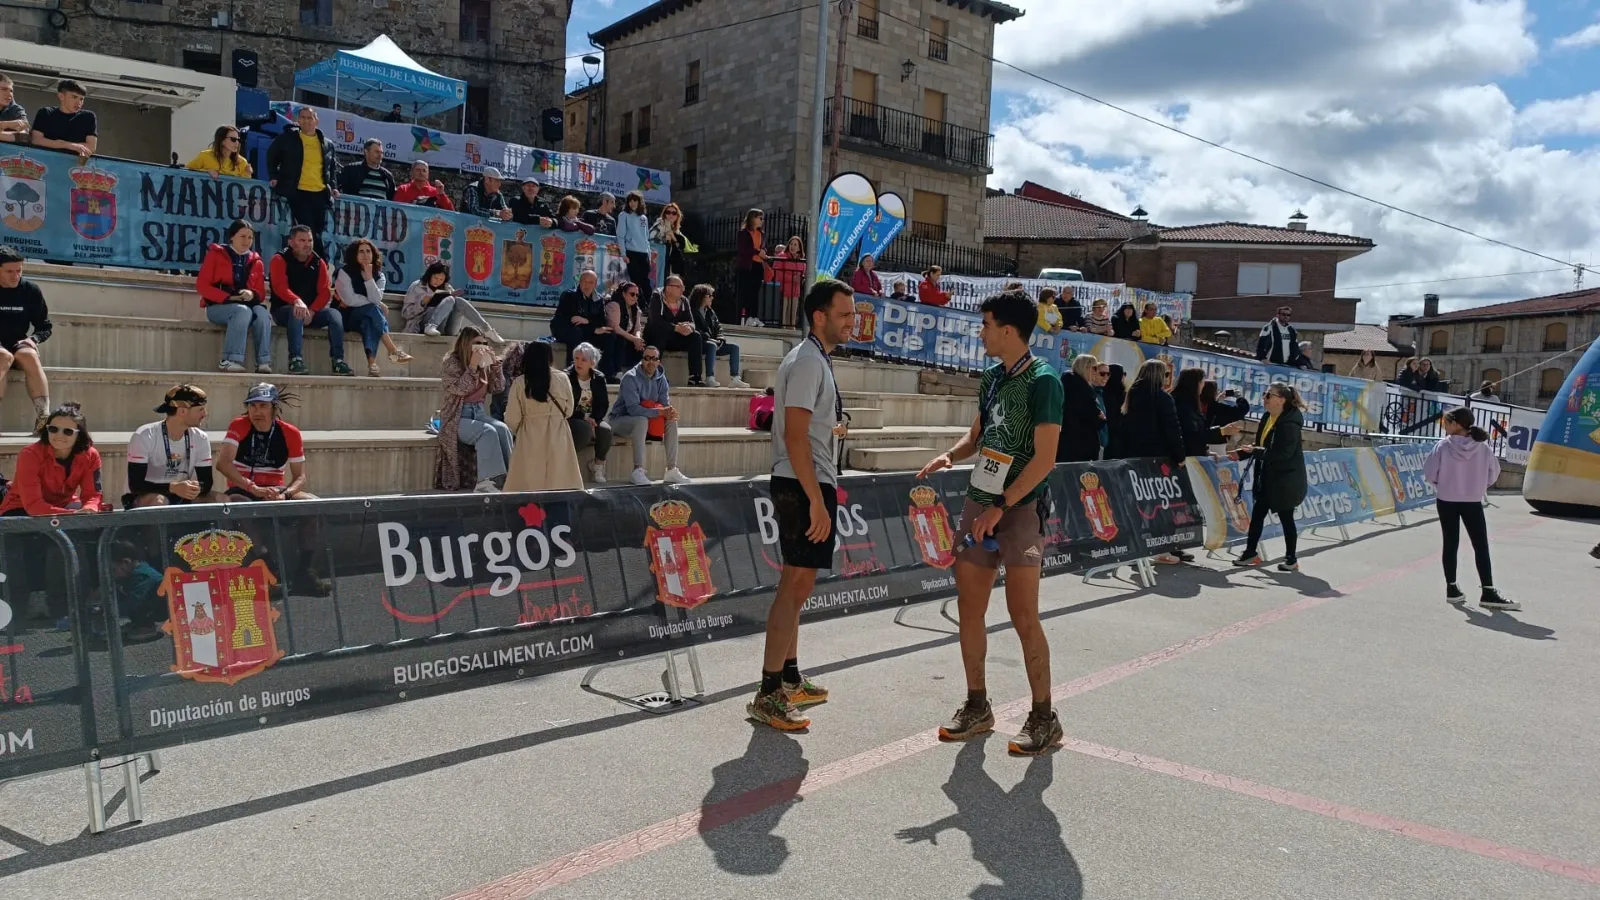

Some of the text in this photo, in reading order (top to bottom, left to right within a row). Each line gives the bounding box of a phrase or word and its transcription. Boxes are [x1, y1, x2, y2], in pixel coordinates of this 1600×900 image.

[339, 57, 389, 78] REGUMIEL
[390, 68, 402, 81] DE
[404, 72, 417, 86] LA
[418, 76, 453, 93] SIERRA
[460, 162, 485, 172] Castill
[140, 171, 408, 243] MANCOMNIDAD
[847, 207, 873, 246] BURGOS
[883, 328, 925, 351] de
[1181, 355, 1329, 395] Diputación
[984, 458, 1001, 475] 225
[1128, 469, 1183, 509] Burgos
[1406, 476, 1424, 499] de
[378, 521, 577, 597] Burgos
[800, 585, 889, 611] OSALIMENTA.COM
[649, 614, 733, 639] Diputación de Burgos
[393, 634, 594, 684] BURGOSALIMENTA.COM
[150, 687, 311, 728] Diputación de Burgos
